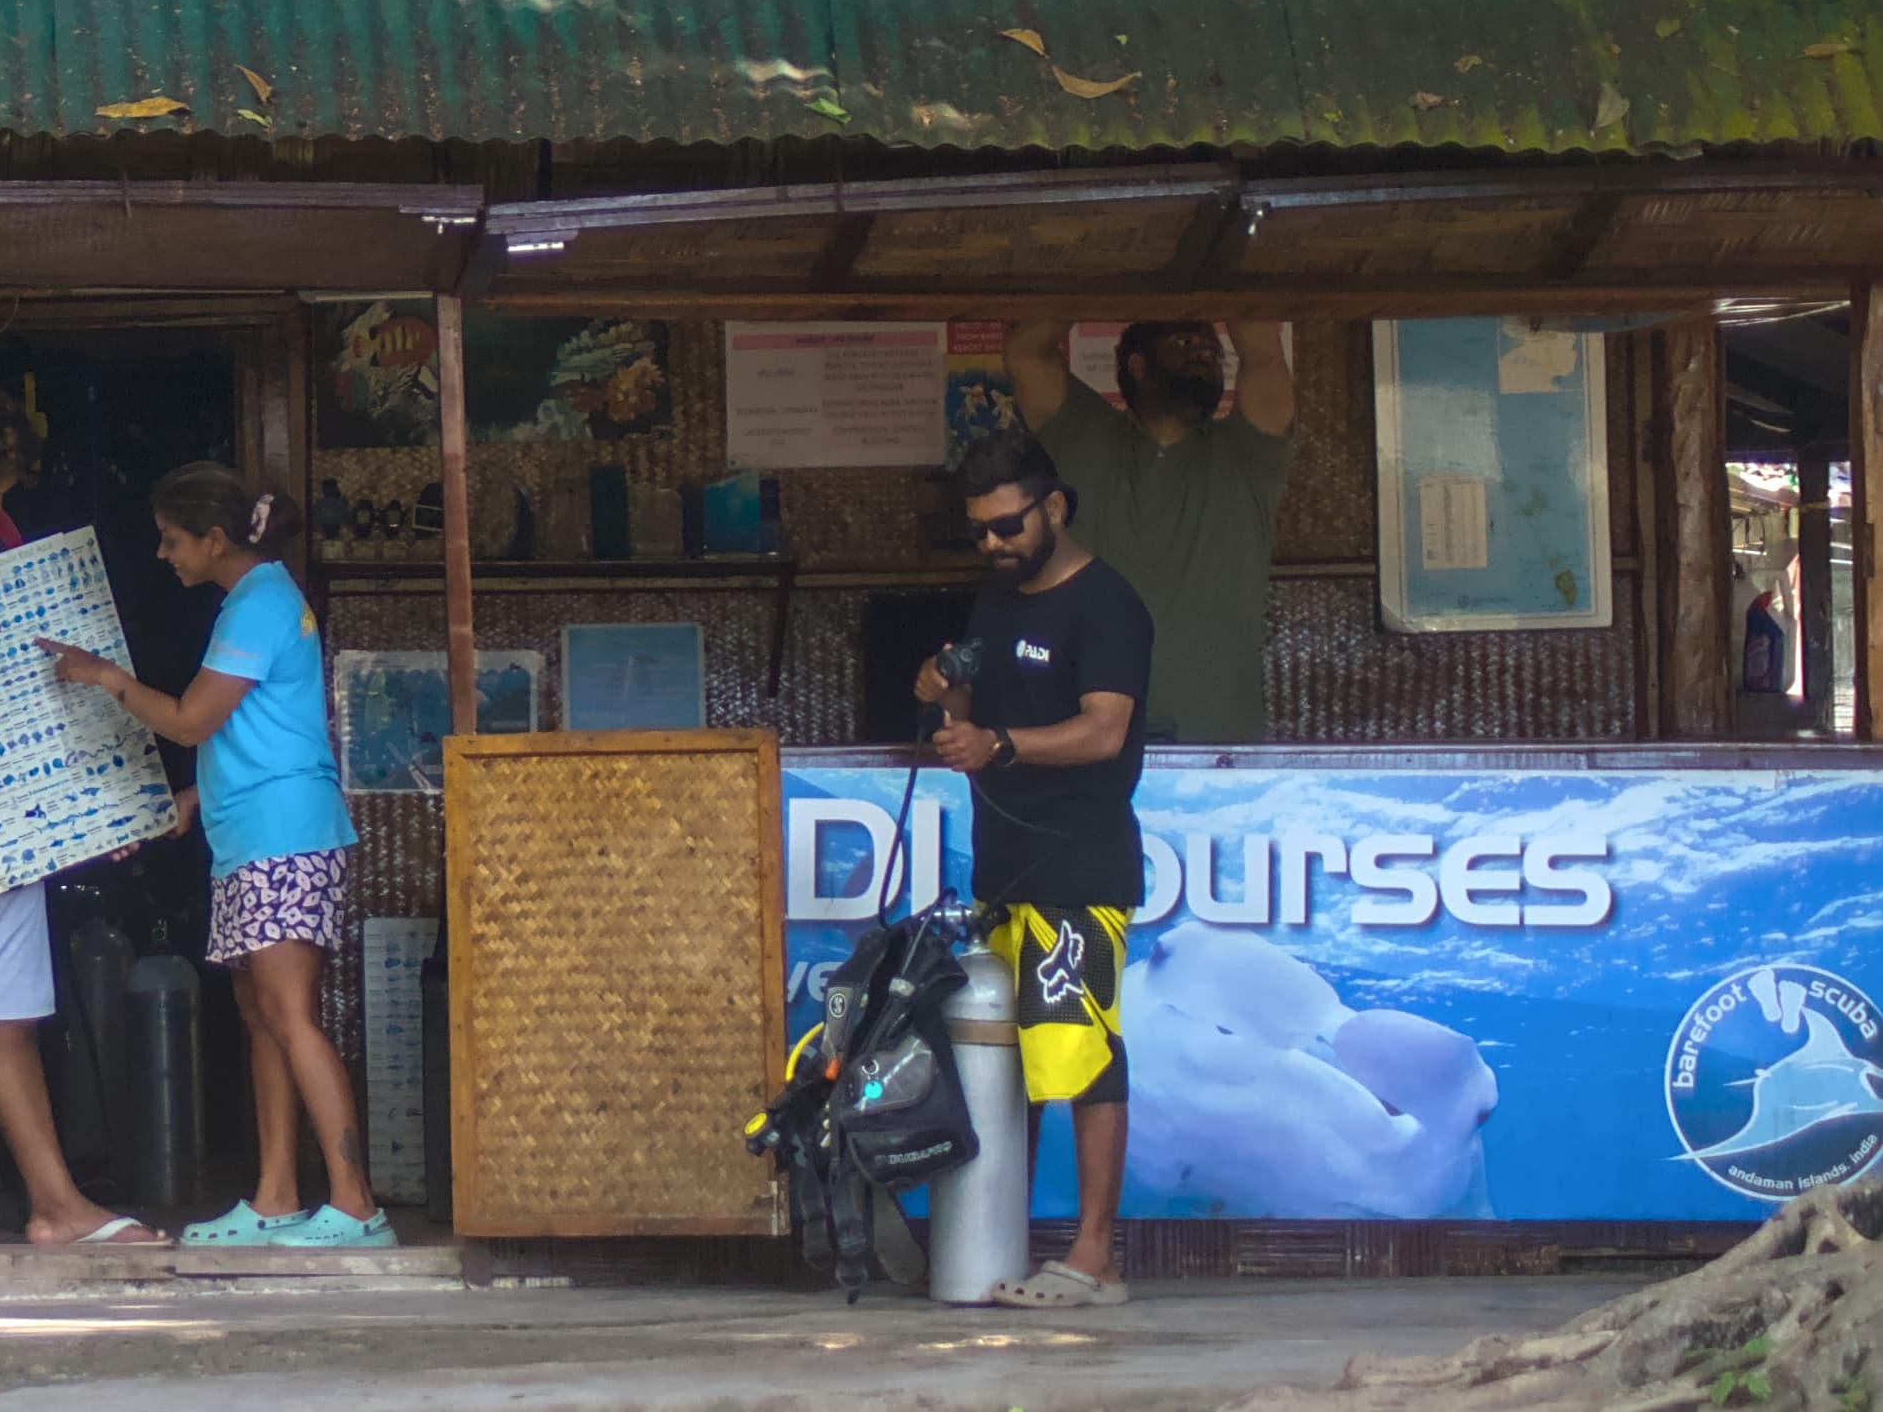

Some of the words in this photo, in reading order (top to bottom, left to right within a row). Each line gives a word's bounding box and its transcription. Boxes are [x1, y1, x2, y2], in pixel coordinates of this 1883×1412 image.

[787, 797, 941, 920] DI
[1129, 832, 1612, 927] ourses
[1672, 982, 1748, 1089] barefoot
[1808, 979, 1879, 1040] scuba
[1727, 1164, 1794, 1190] andaman
[1848, 1134, 1878, 1164] india
